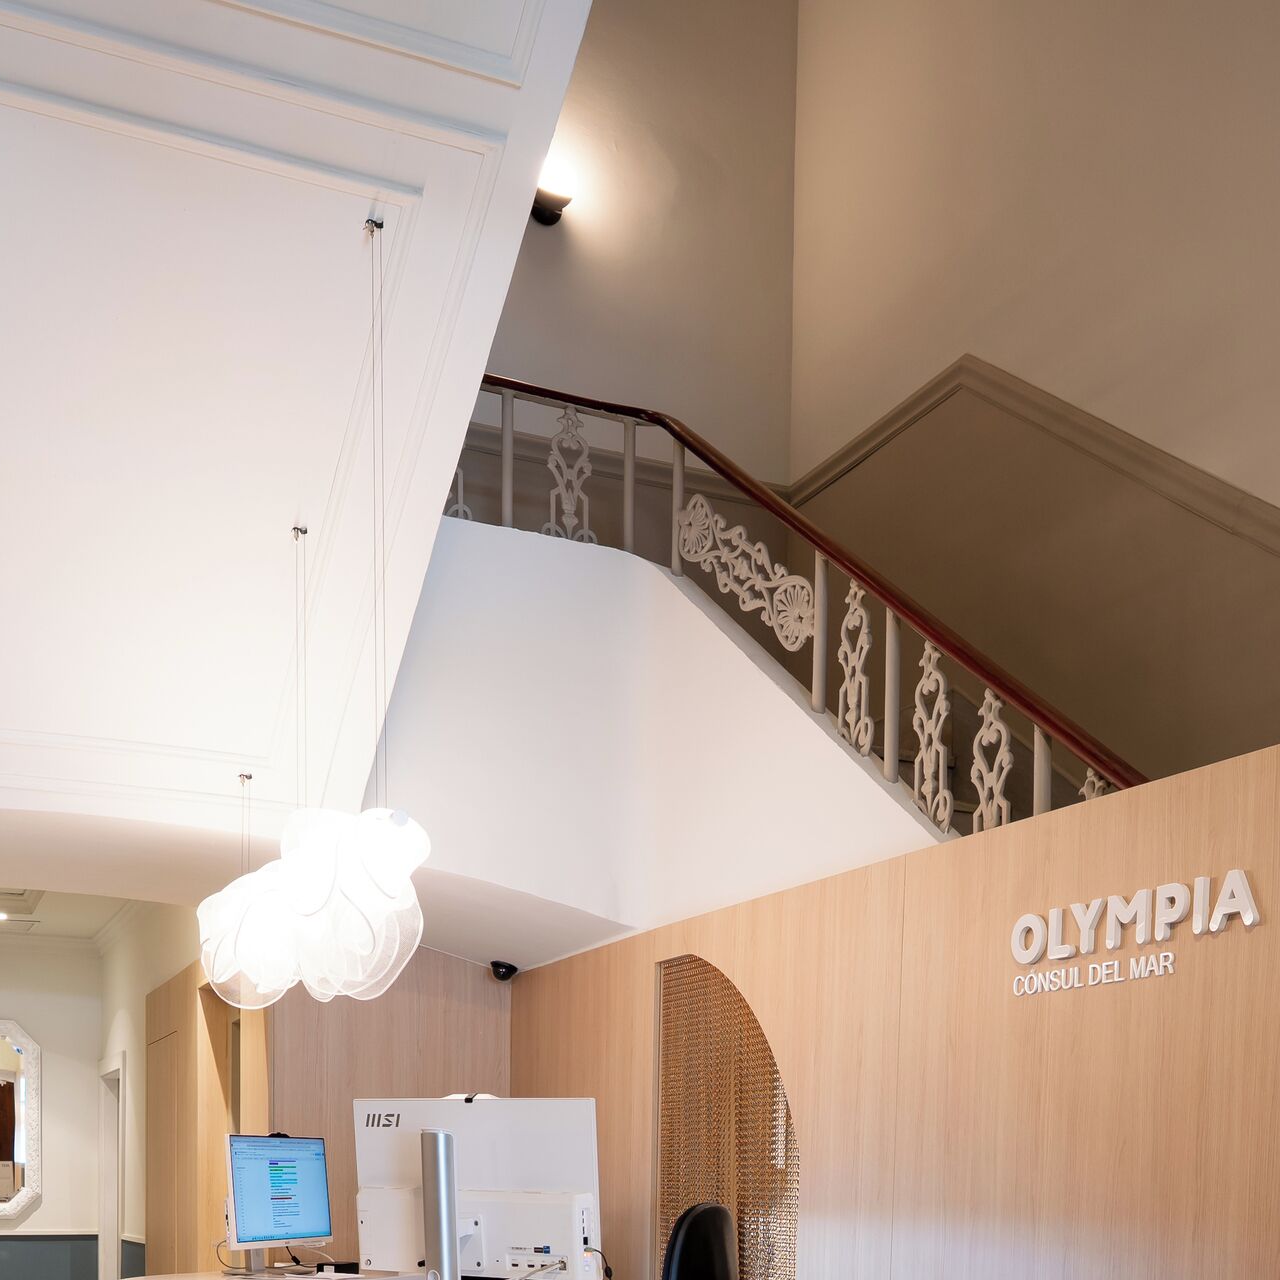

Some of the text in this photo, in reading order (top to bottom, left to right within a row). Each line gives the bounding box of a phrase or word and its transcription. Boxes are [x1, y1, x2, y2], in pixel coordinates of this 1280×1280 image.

[1011, 869, 1260, 964] OLYMPIA
[1013, 952, 1175, 996] CÓNSUL DEL MAR
